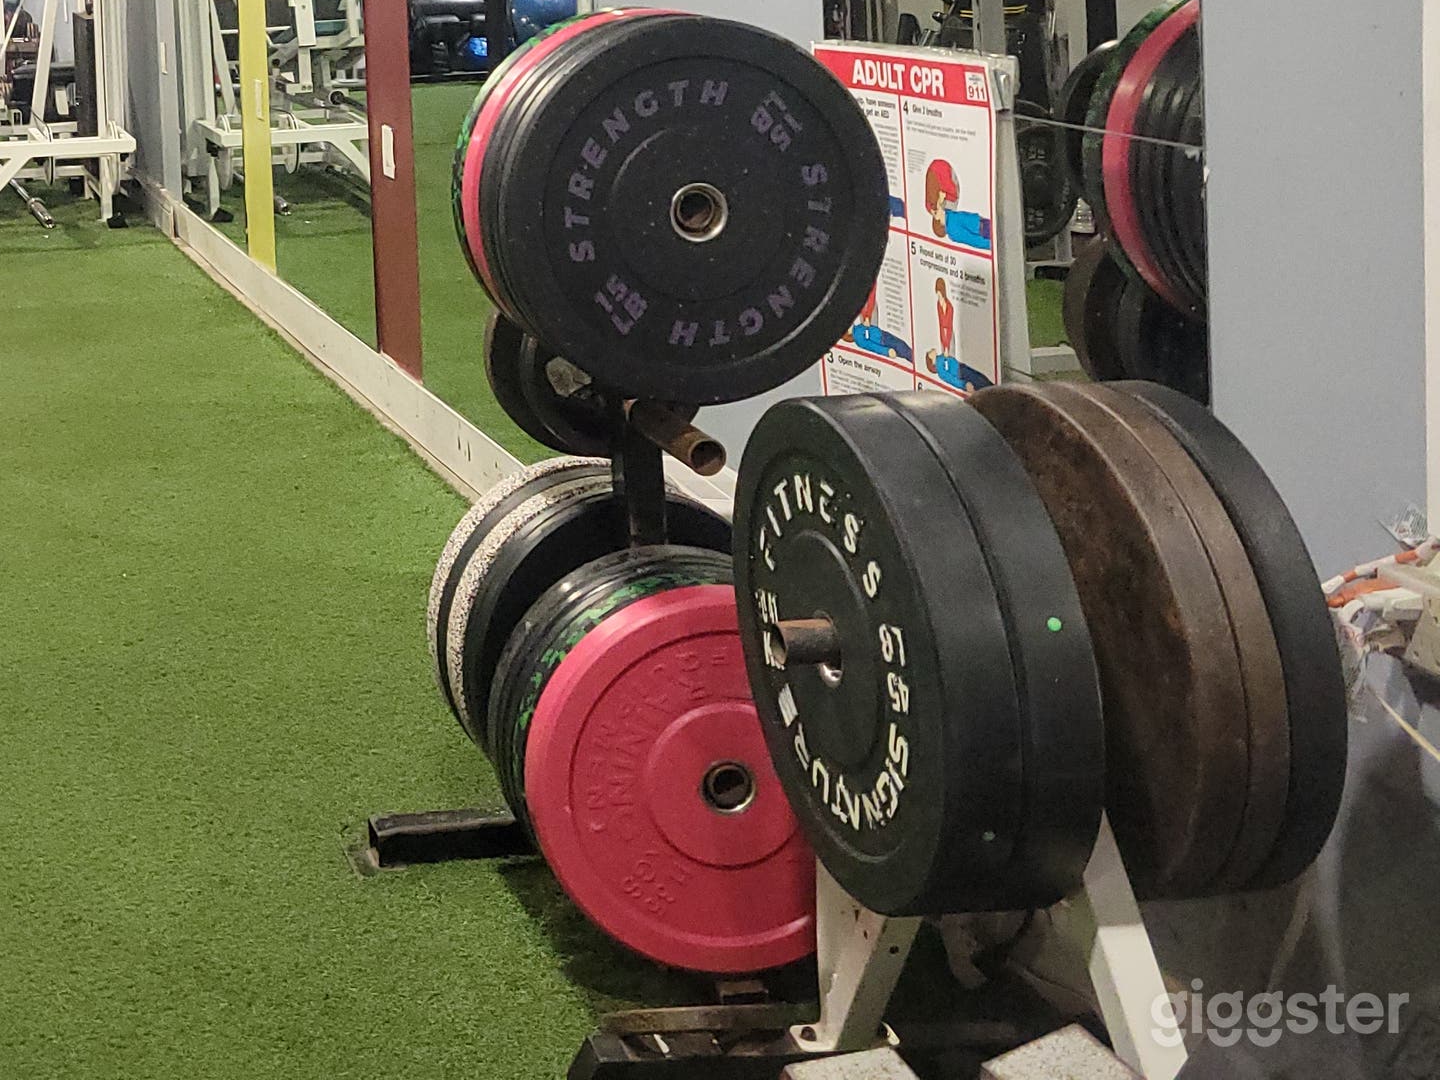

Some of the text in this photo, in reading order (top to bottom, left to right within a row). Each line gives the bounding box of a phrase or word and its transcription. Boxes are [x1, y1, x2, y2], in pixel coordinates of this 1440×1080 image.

[852, 59, 945, 98] ADULT CPR
[968, 85, 986, 100] 911
[903, 100, 909, 115] 4
[564, 79, 728, 263] STRENGTH
[669, 163, 833, 348] STRENGTH
[911, 241, 917, 255] 5
[949, 255, 957, 266] 30
[827, 352, 834, 363] 3
[838, 355, 882, 378] Open the airway
[760, 474, 882, 599] FITNESS
[879, 622, 905, 667] LB
[778, 683, 909, 831] SIGNATURE
